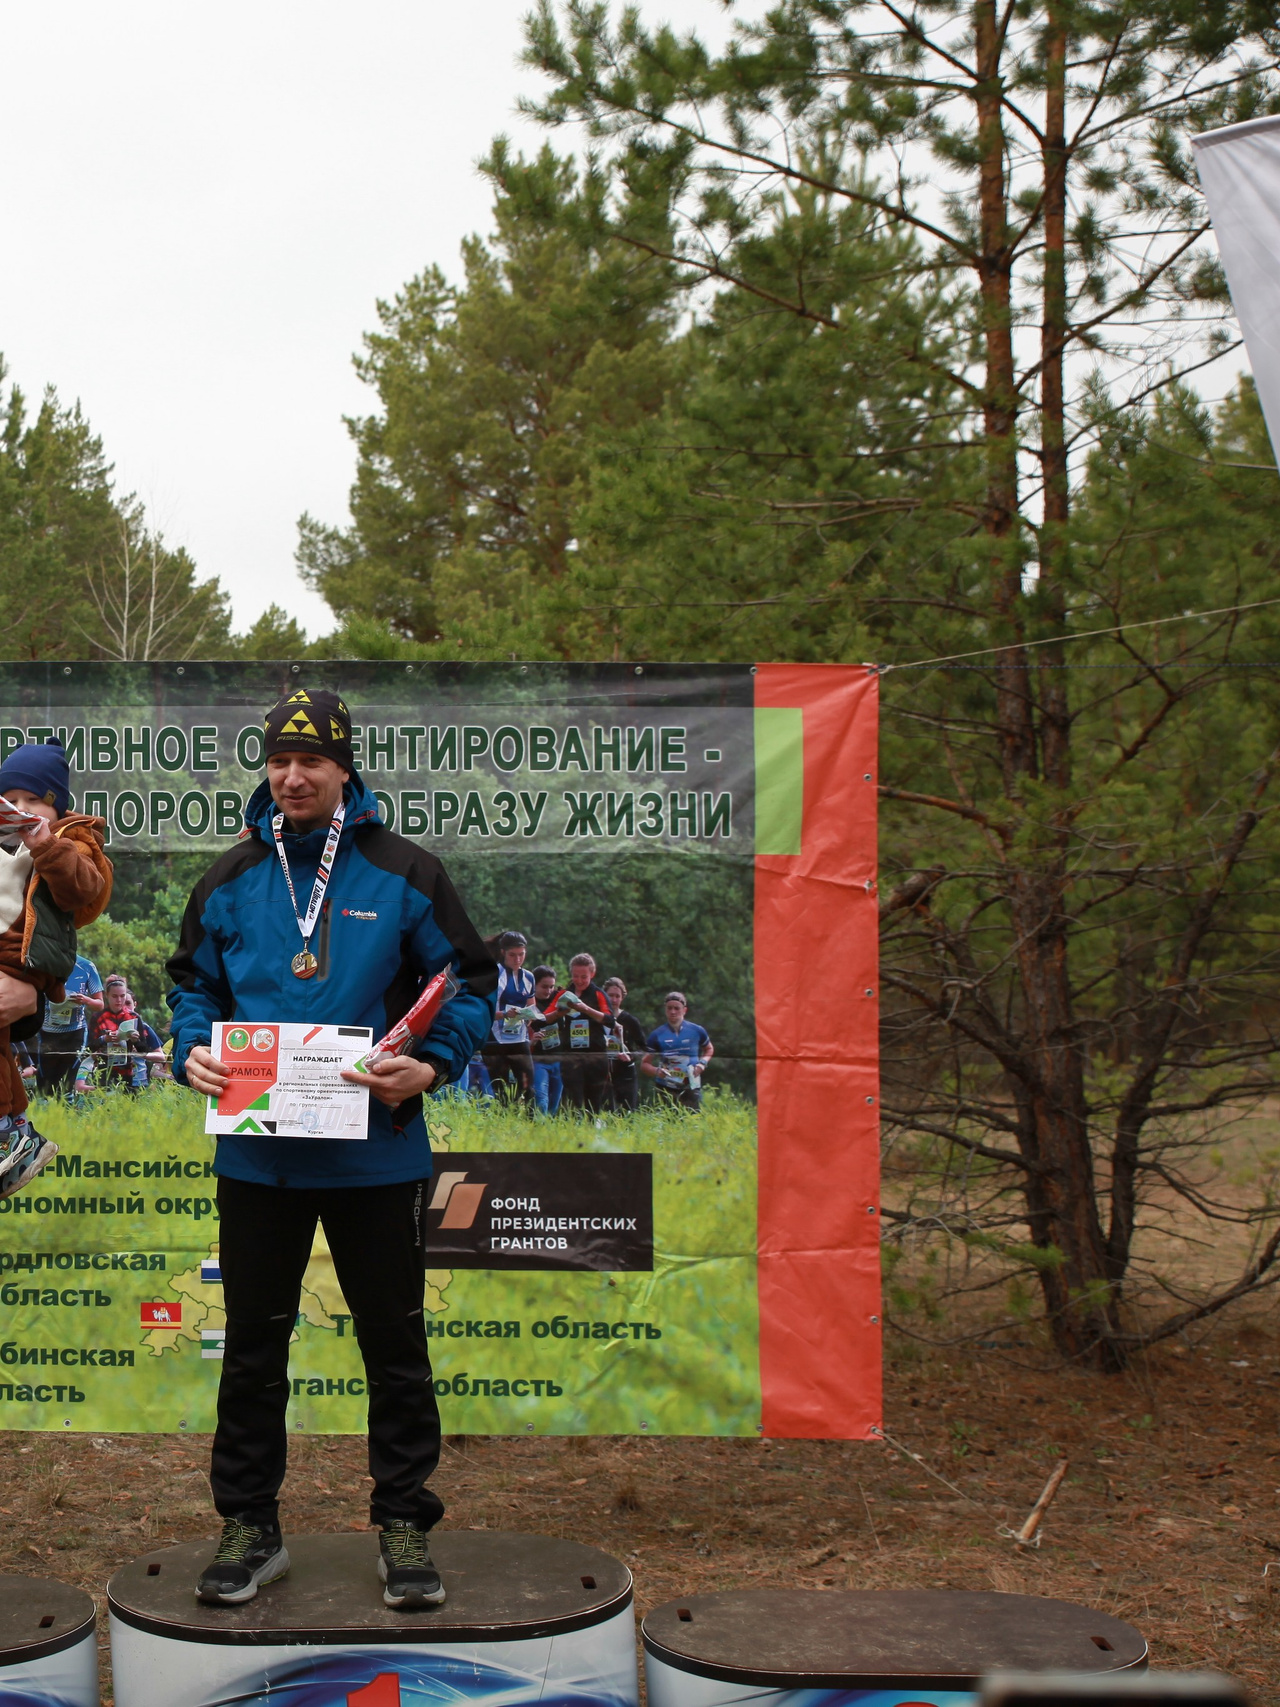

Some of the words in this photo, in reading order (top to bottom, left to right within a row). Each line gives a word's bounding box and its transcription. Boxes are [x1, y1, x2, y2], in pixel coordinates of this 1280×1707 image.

[236, 725, 687, 773] ОЕНТИРОВАНИЕ
[276, 735, 323, 745] FISCHER
[563, 791, 732, 839] ЖИЗНИ
[491, 1197, 541, 1212] ФОНД
[491, 1217, 637, 1232] ПРЕЗИДЕНТСКИХ
[491, 1237, 568, 1250] ГРАНТОВ
[531, 1315, 662, 1340] область
[433, 1372, 563, 1398] область
